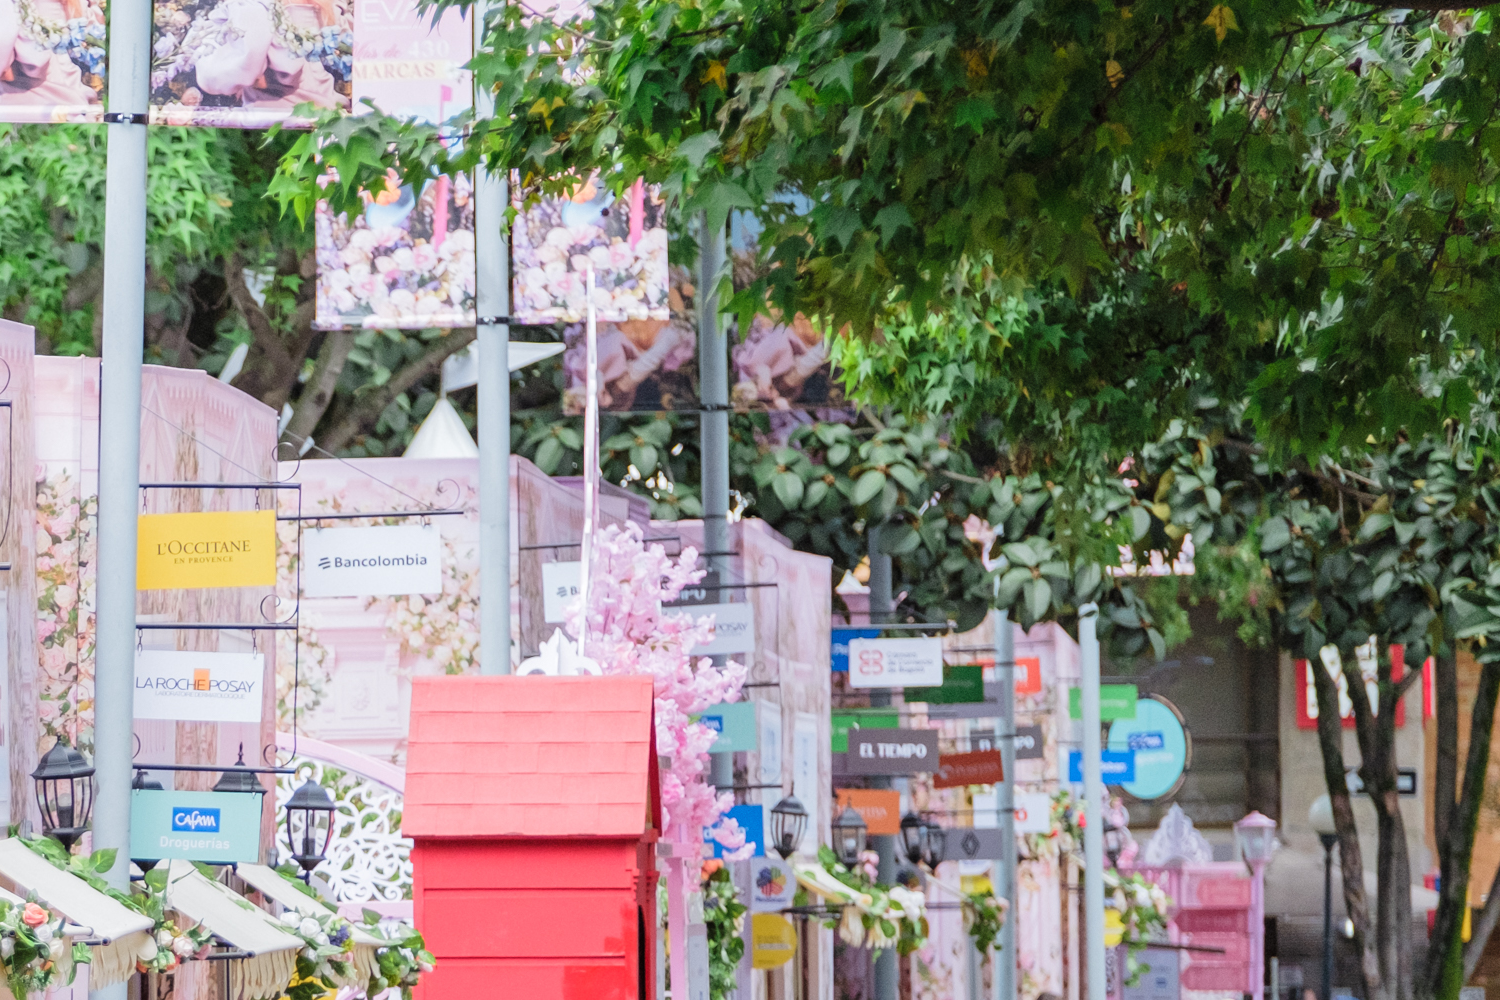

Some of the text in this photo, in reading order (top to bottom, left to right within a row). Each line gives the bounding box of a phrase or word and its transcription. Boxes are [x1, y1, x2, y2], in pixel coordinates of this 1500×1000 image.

[408, 40, 450, 58] 430
[353, 62, 435, 79] MARCAS
[188, 556, 233, 564] PROVENCE
[334, 554, 427, 568] Bancolombia
[135, 677, 255, 692] LA ROCHE POSAY
[859, 743, 928, 759] EL TIEMPO
[159, 836, 230, 851] Droguerías
